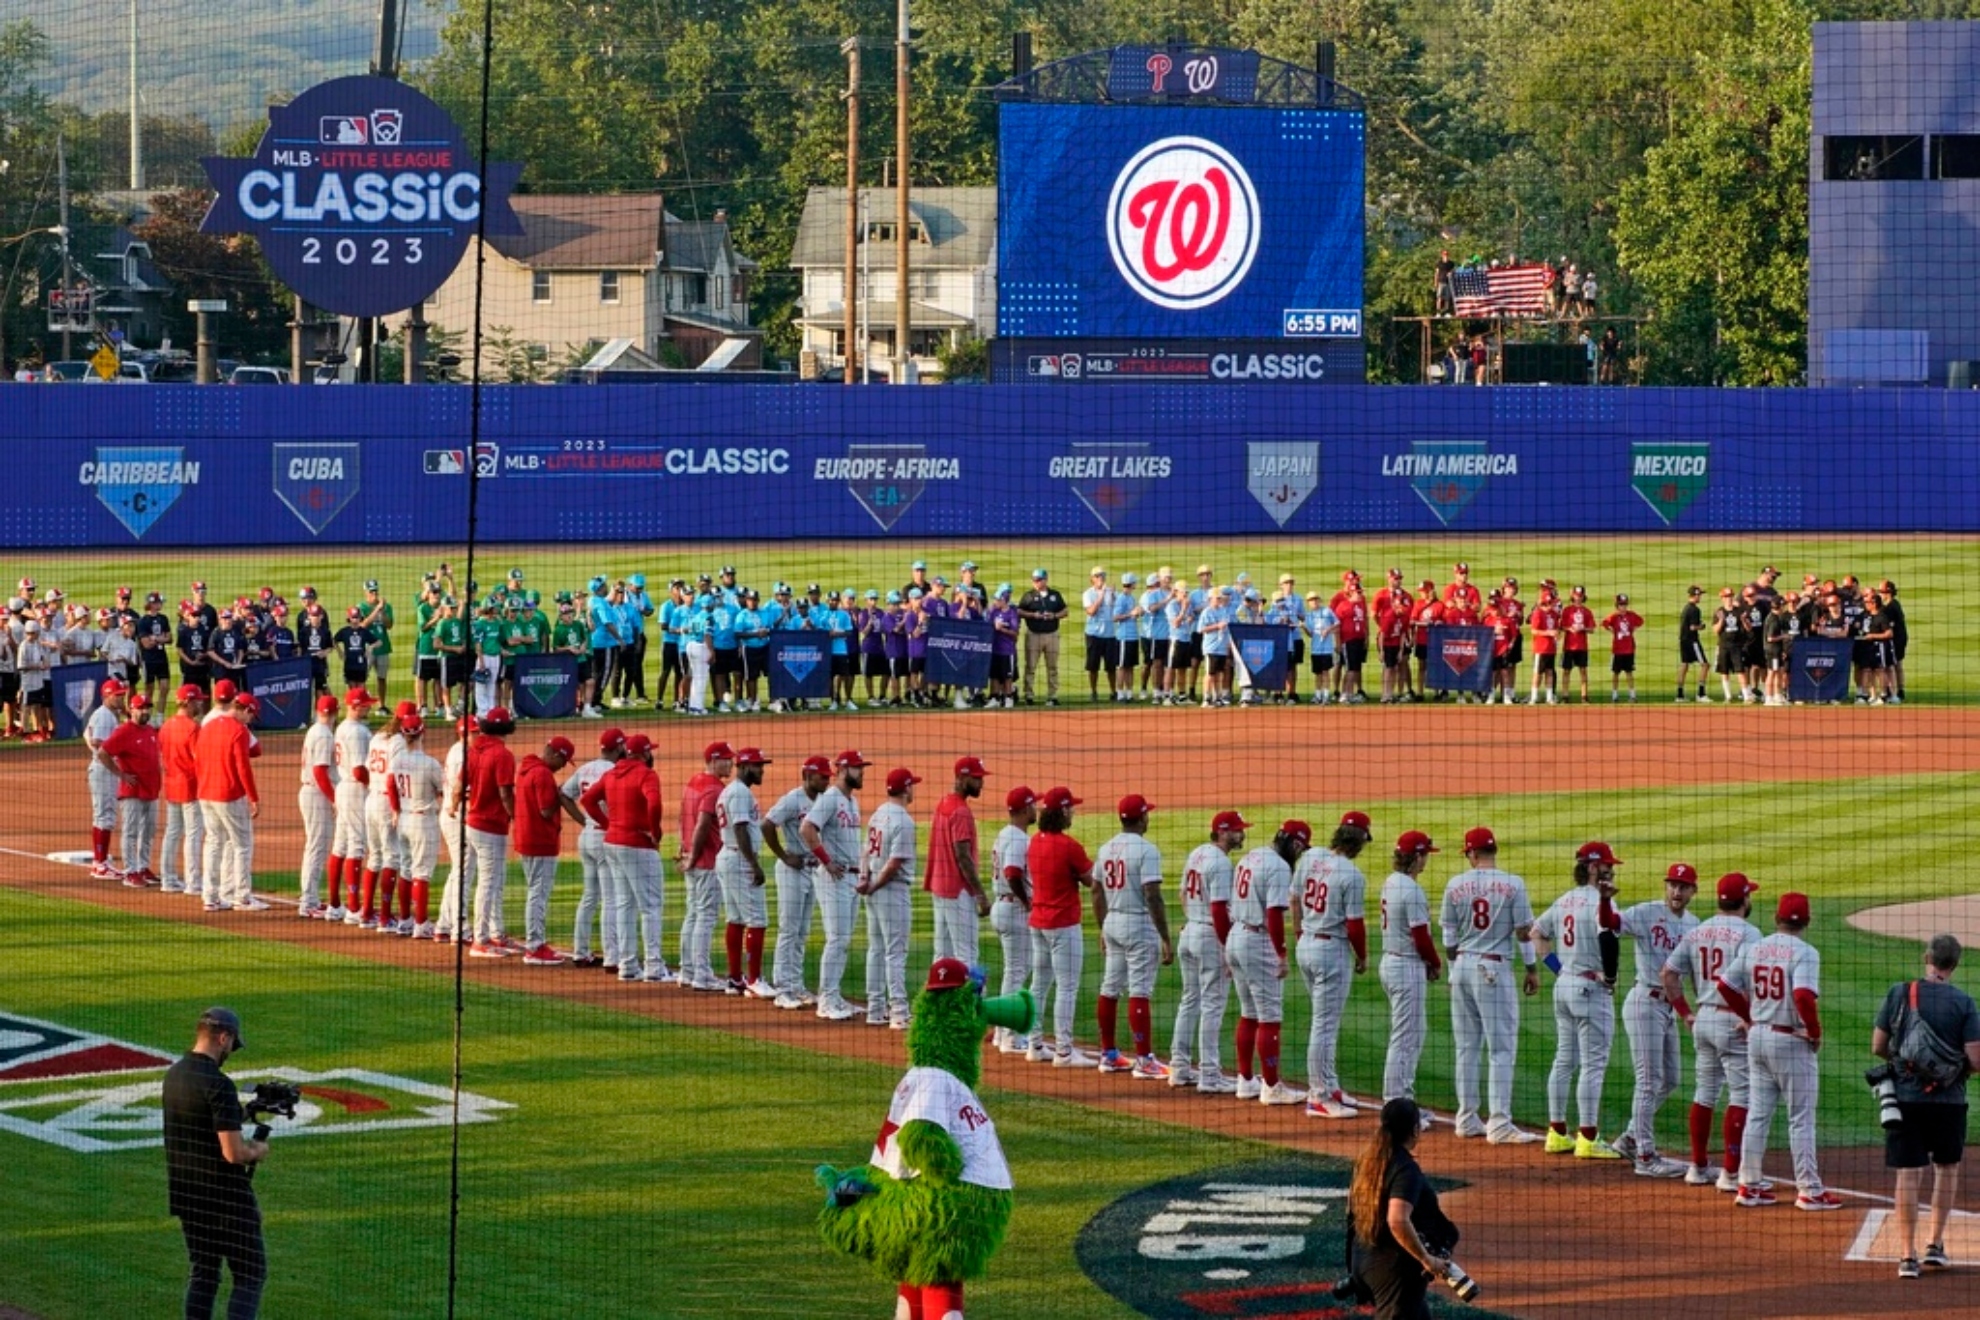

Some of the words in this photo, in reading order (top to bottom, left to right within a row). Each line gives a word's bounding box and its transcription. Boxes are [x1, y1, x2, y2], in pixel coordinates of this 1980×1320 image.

[1146, 53, 1172, 93] P
[1184, 56, 1217, 93] W
[273, 150, 312, 166] MLB
[383, 153, 451, 168] LEAGUE
[238, 169, 482, 223] CLASSiC
[1128, 167, 1231, 283] W
[302, 237, 423, 265] 2023
[1286, 314, 1326, 333] 6:55
[1330, 314, 1357, 333] PM
[1131, 348, 1165, 356] 2023
[1087, 360, 1113, 372] MLB
[1210, 354, 1324, 379] CLASSiC
[563, 440, 606, 450] 2023
[79, 461, 200, 484] CARIBBEAN
[288, 457, 344, 480] CUBA
[505, 456, 539, 469] MLB
[601, 455, 662, 469] LEAGUE
[665, 448, 790, 474] CLASSiC
[814, 457, 960, 480] EUROPE-AFRICA
[1049, 456, 1108, 478] GREAT
[1111, 456, 1172, 478] LAKES
[1253, 456, 1313, 477] JAPAN
[1382, 455, 1433, 476] LATIN
[1435, 454, 1518, 475] AMERICA
[1633, 456, 1706, 476] MEXICO
[133, 493, 146, 513] C
[875, 487, 898, 505] EA
[1276, 484, 1289, 503] J
[1806, 657, 1835, 667] METRO
[370, 749, 388, 774] 25
[1304, 878, 1328, 913] 28
[1472, 898, 1490, 930] 8
[1564, 914, 1575, 947] 3
[1699, 946, 1724, 981] 12
[1753, 965, 1786, 1001] 59
